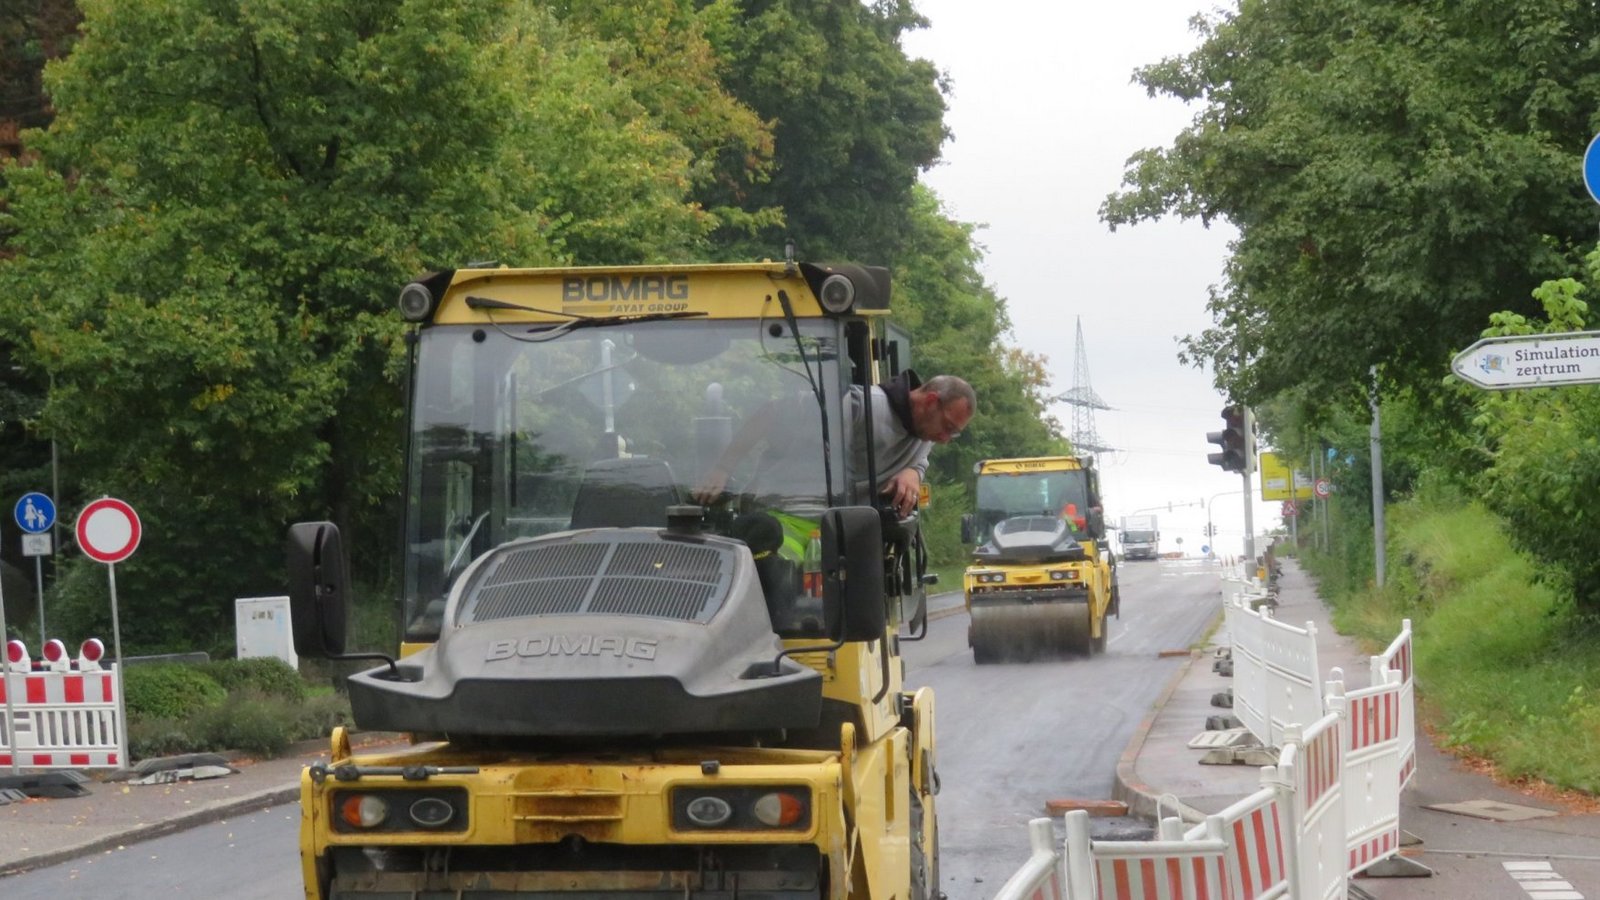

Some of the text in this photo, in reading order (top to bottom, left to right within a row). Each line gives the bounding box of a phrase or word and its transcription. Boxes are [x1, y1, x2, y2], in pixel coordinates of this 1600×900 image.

[563, 275, 688, 301] BOMAG
[609, 303, 688, 313] FAYAT GROUP
[1516, 363, 1581, 377] zentrum
[485, 635, 658, 662] BOMAG
